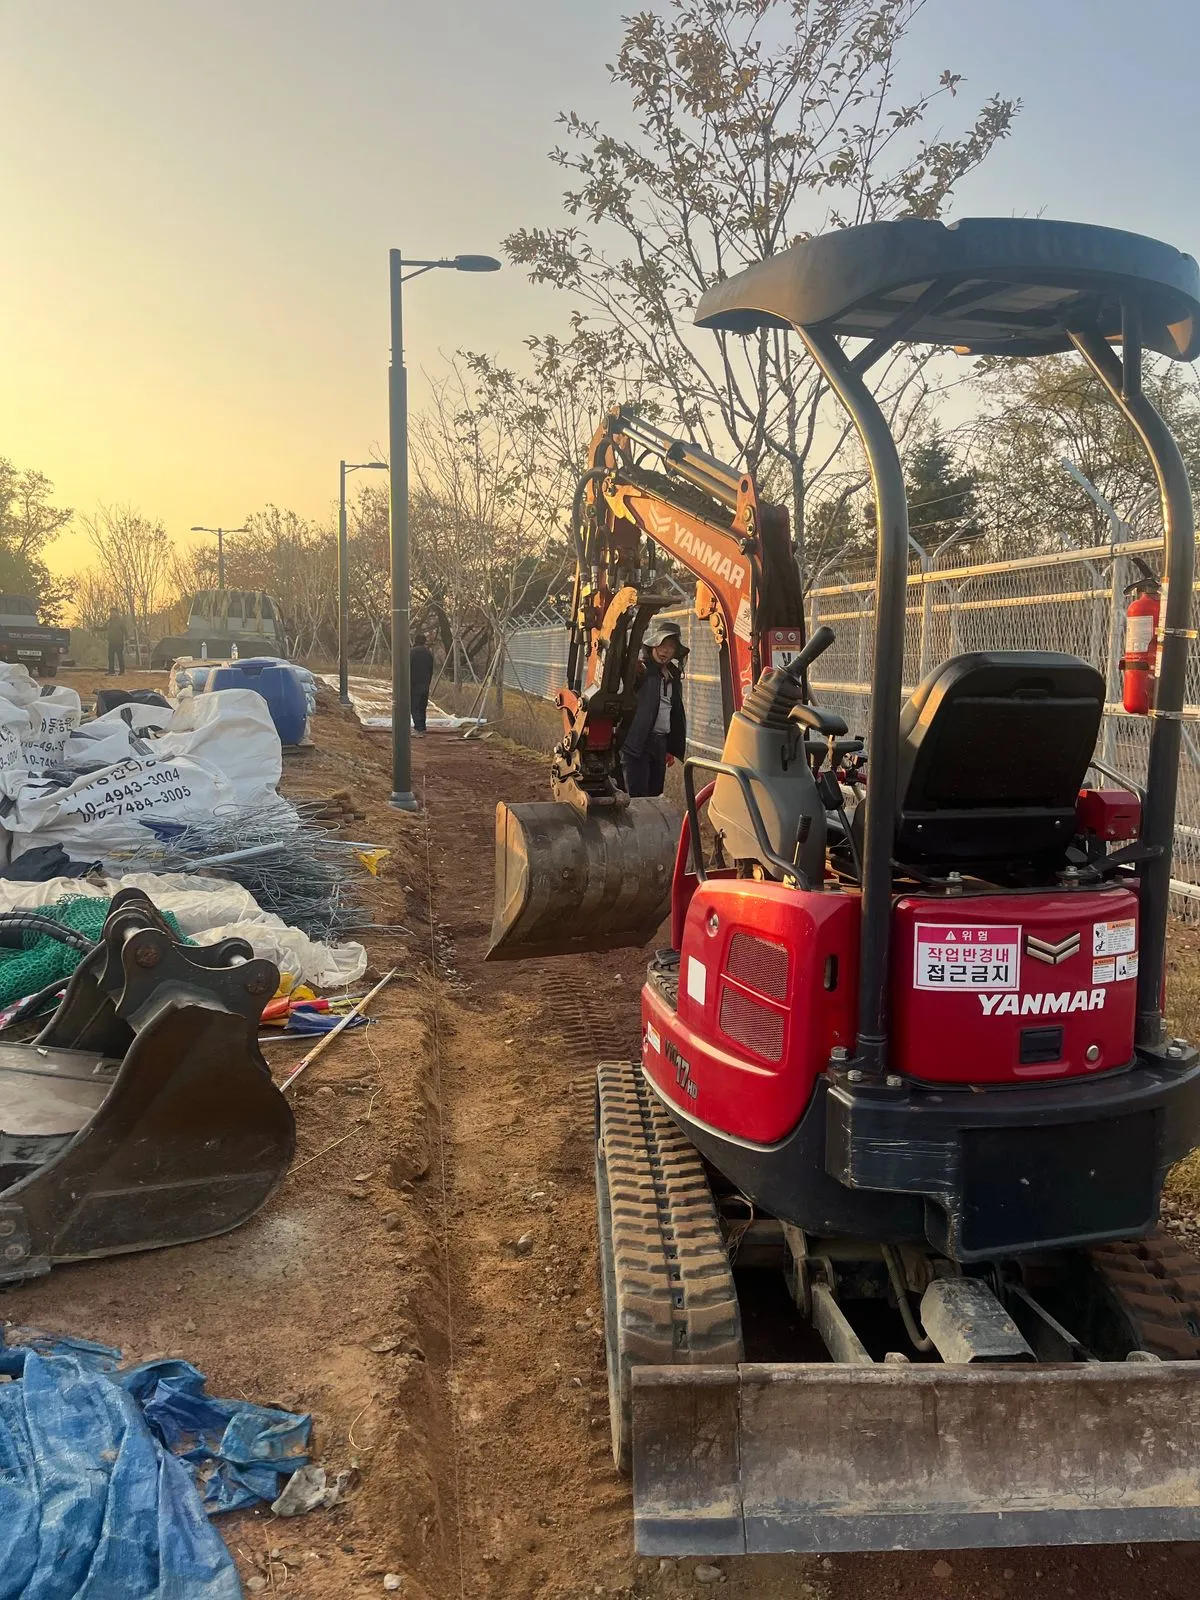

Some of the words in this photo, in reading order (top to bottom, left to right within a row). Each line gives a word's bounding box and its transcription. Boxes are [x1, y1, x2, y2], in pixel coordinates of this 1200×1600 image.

[671, 522, 745, 589] YANMAR
[927, 947, 1009, 963] 작업반경내
[927, 964, 1009, 983] 접근금지
[978, 988, 1106, 1016] YANMAR
